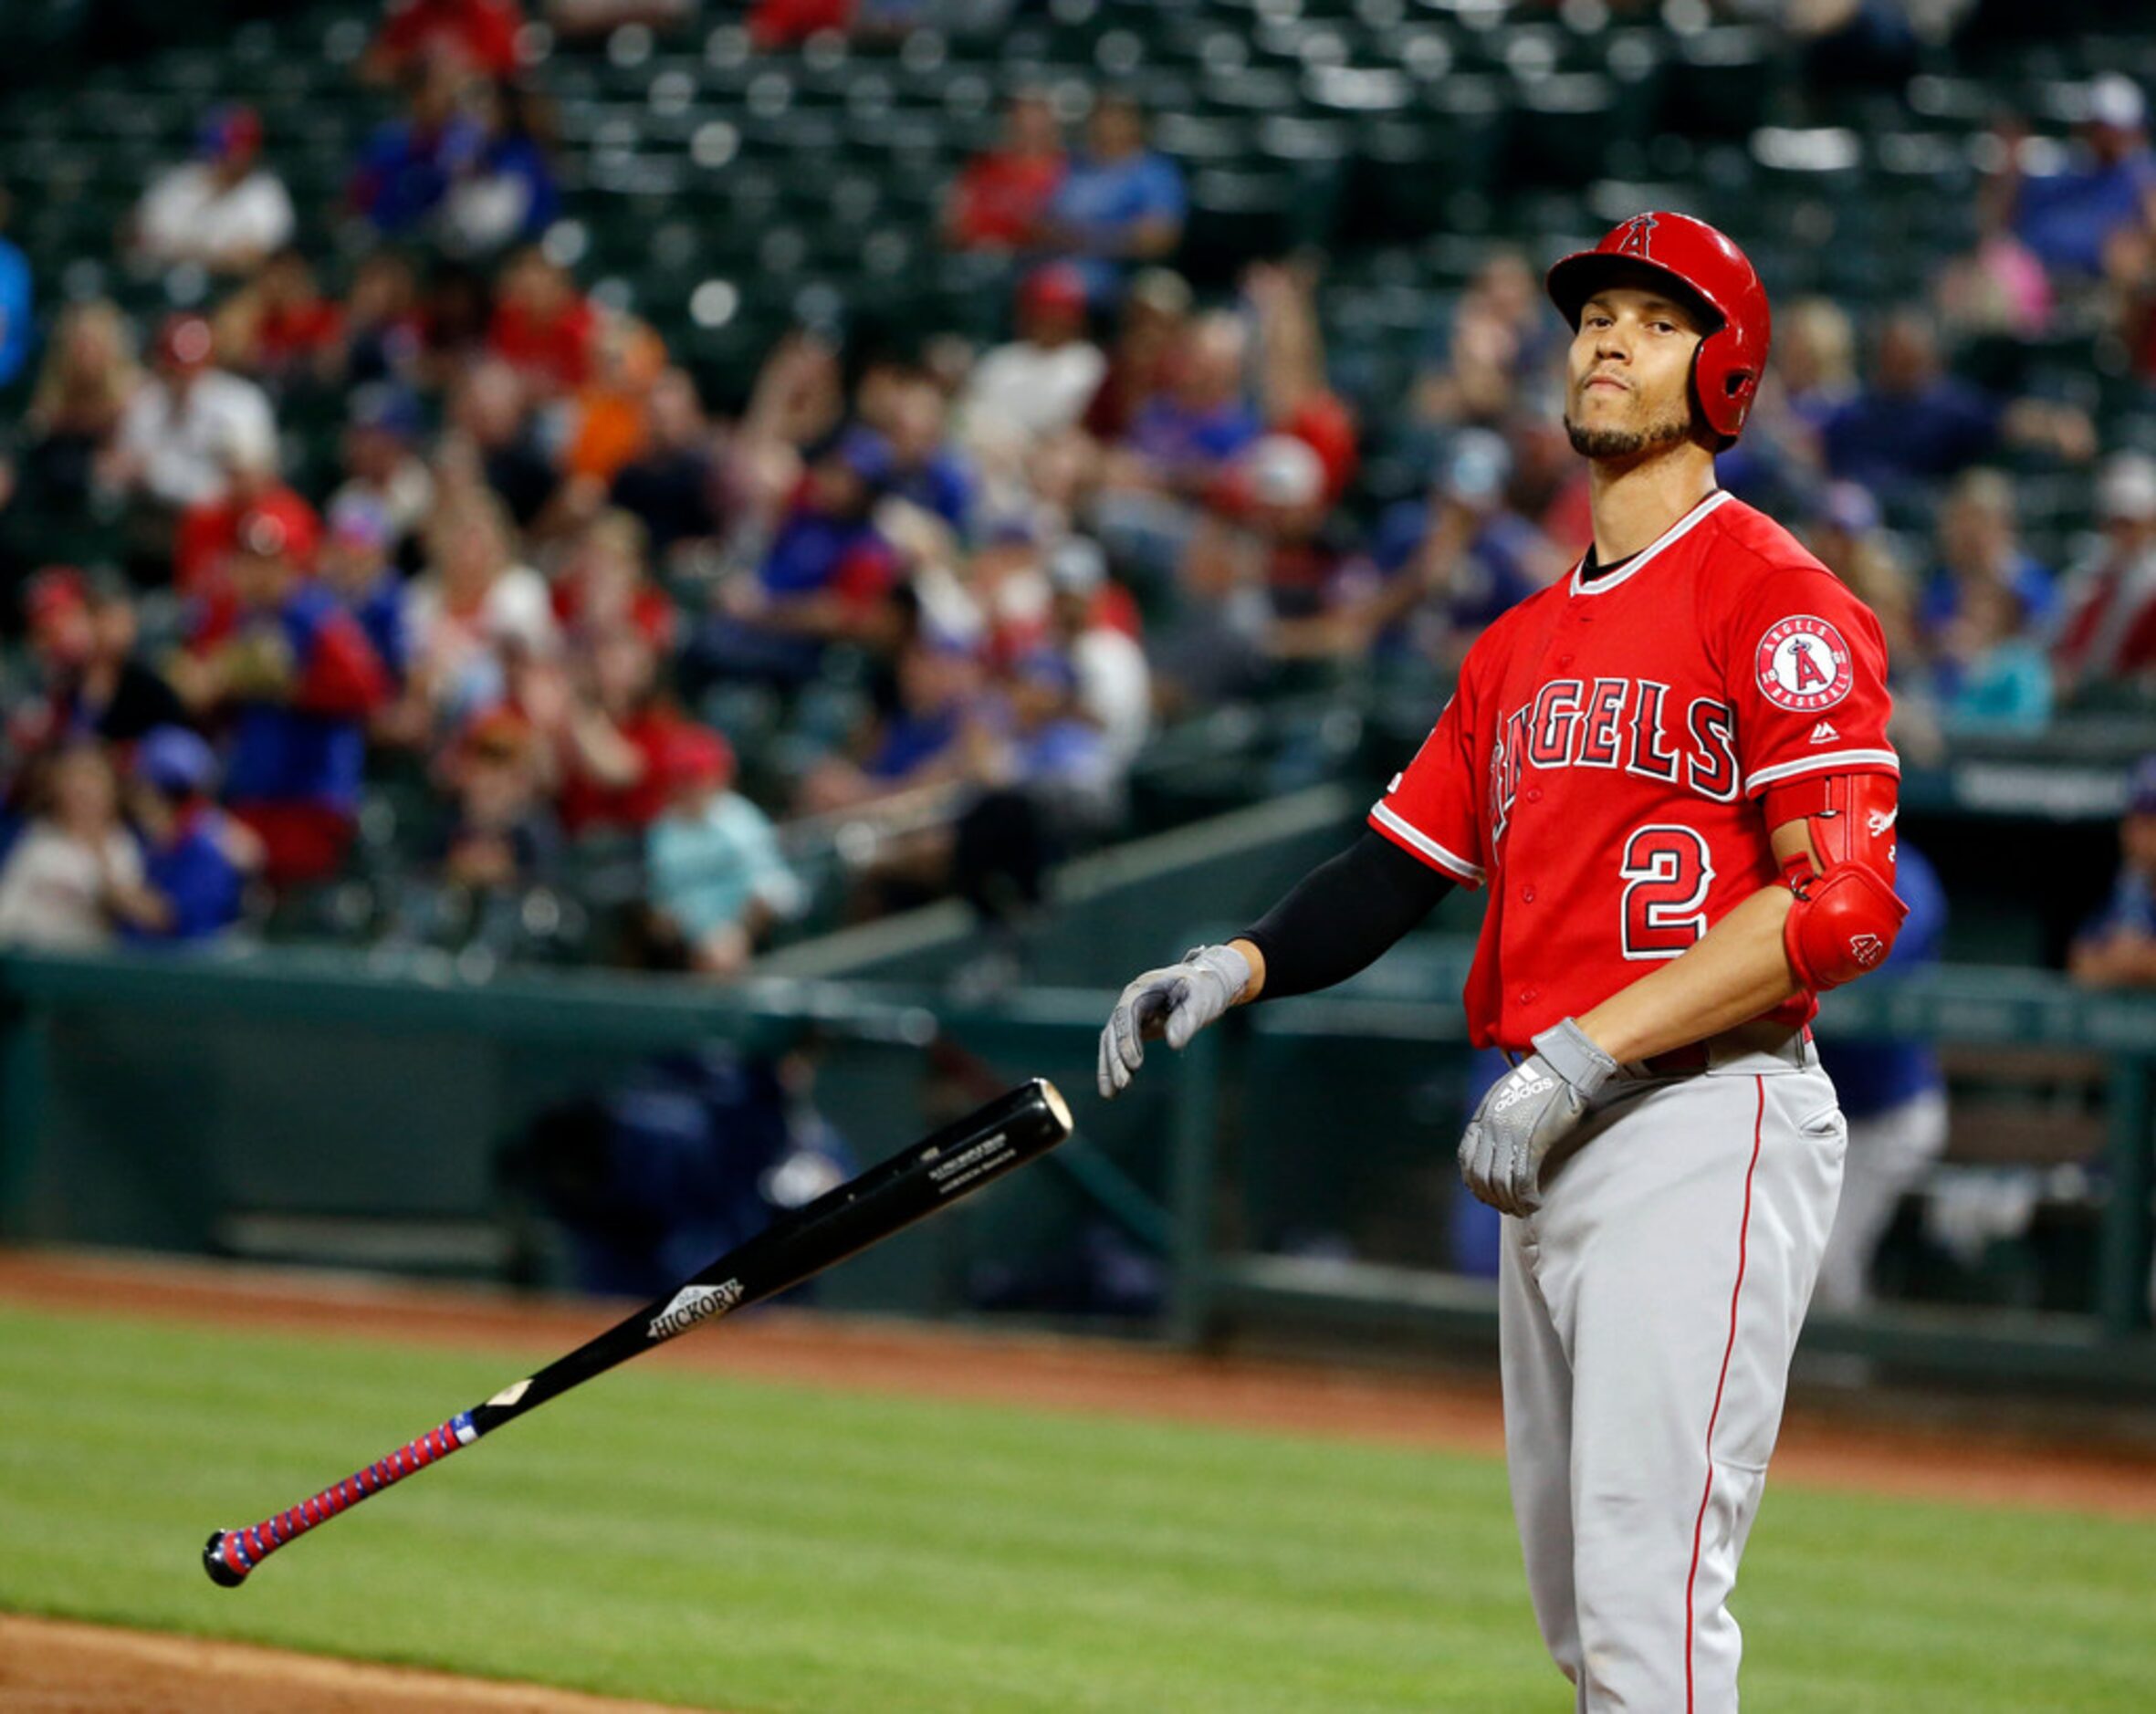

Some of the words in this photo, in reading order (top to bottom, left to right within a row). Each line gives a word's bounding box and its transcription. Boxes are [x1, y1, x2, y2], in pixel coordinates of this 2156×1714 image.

[1764, 620, 1827, 652] ANGELS
[1770, 672, 1849, 707] BASEBALL
[1491, 678, 1739, 826] NGELS
[1619, 824, 1716, 960] 2
[1493, 1077, 1554, 1113] adidas
[654, 1280, 740, 1340] HICKORY
